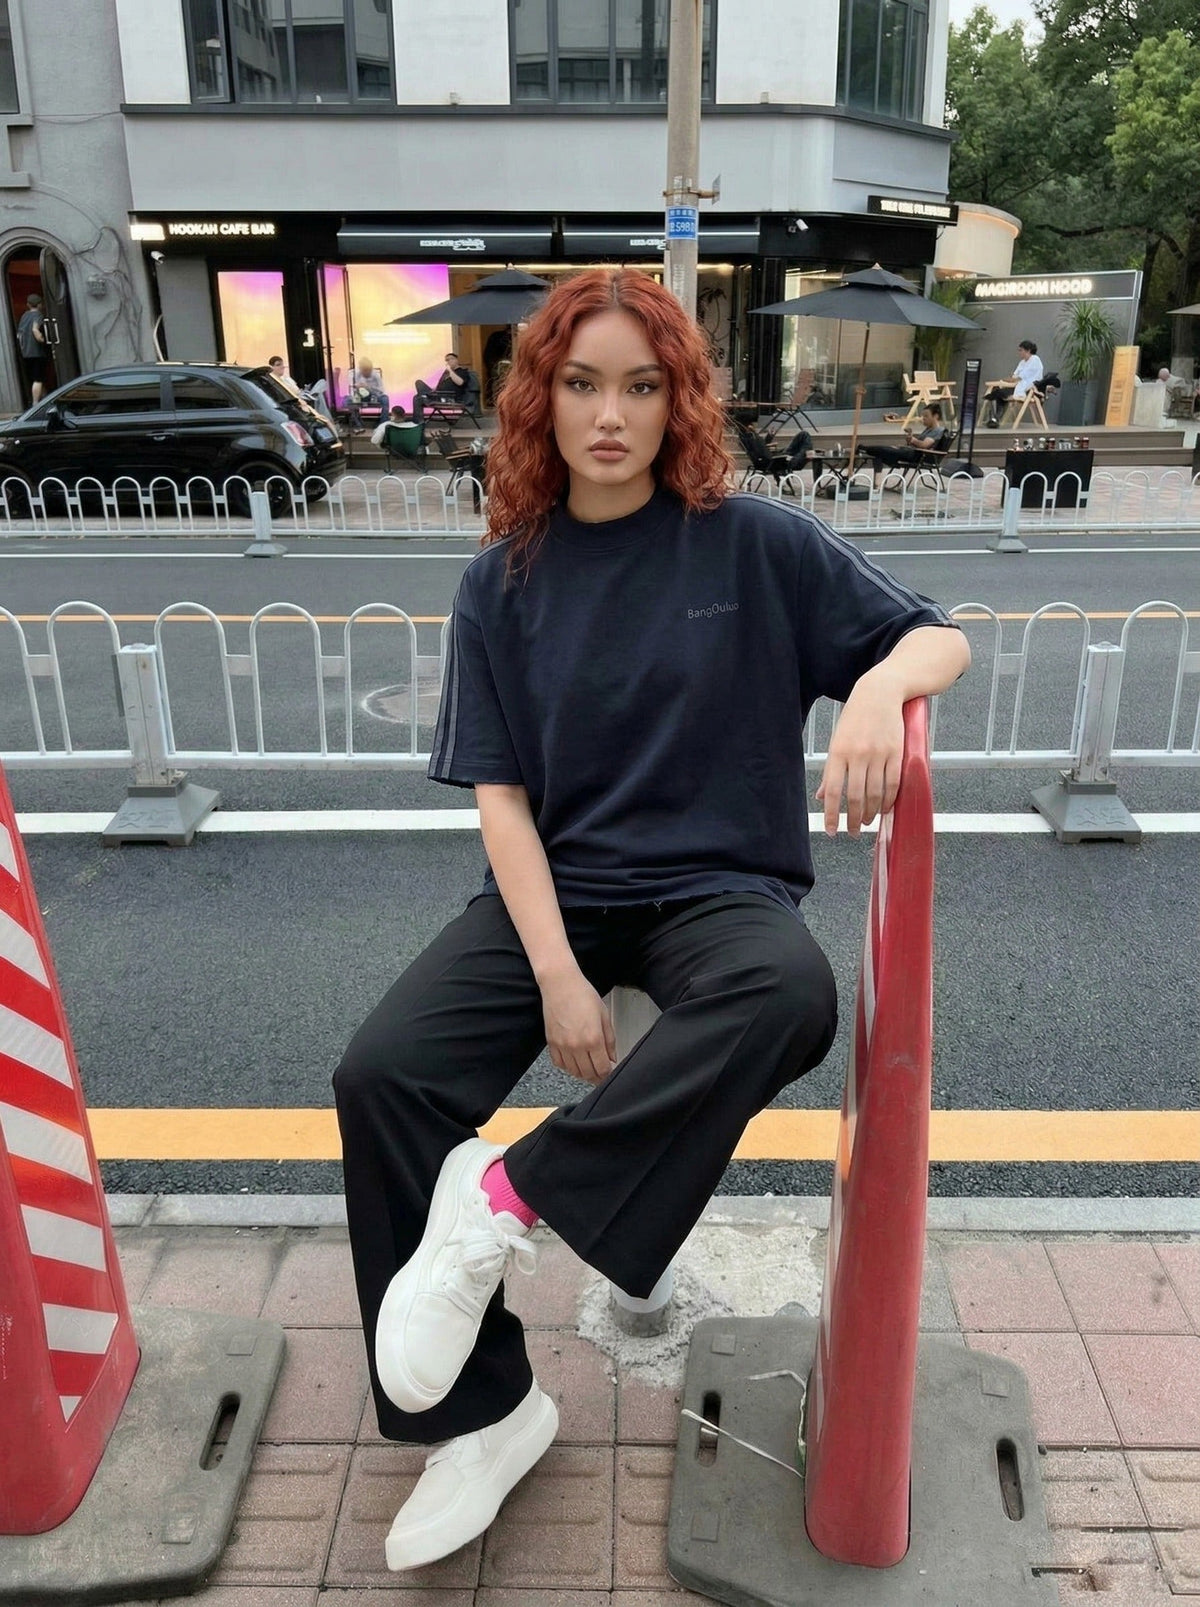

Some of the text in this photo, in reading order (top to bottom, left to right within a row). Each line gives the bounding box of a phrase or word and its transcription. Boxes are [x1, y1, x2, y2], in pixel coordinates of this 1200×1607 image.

[169, 223, 218, 235] HOOKAH
[220, 223, 249, 235] CAFE
[251, 223, 275, 235] BAR
